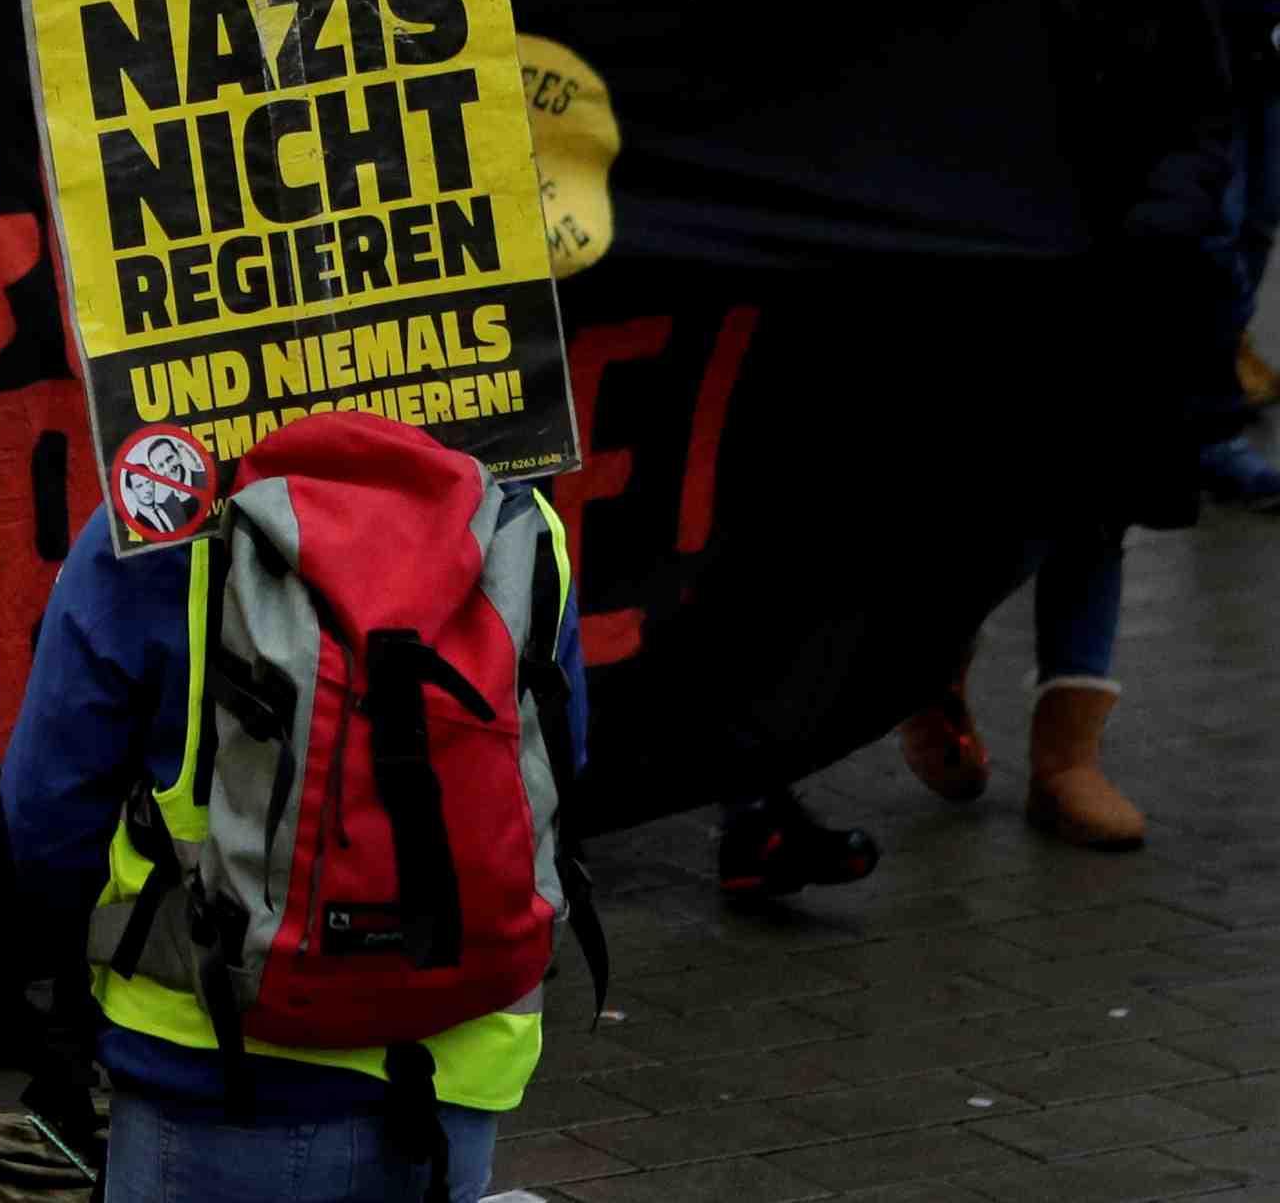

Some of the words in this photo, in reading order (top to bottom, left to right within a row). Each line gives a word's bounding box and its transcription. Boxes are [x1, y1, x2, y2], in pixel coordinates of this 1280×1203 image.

[96, 68, 481, 252] NICHT
[115, 194, 503, 338] REGIEREN
[129, 348, 252, 425] UND
[260, 303, 514, 402] NIEMALS
